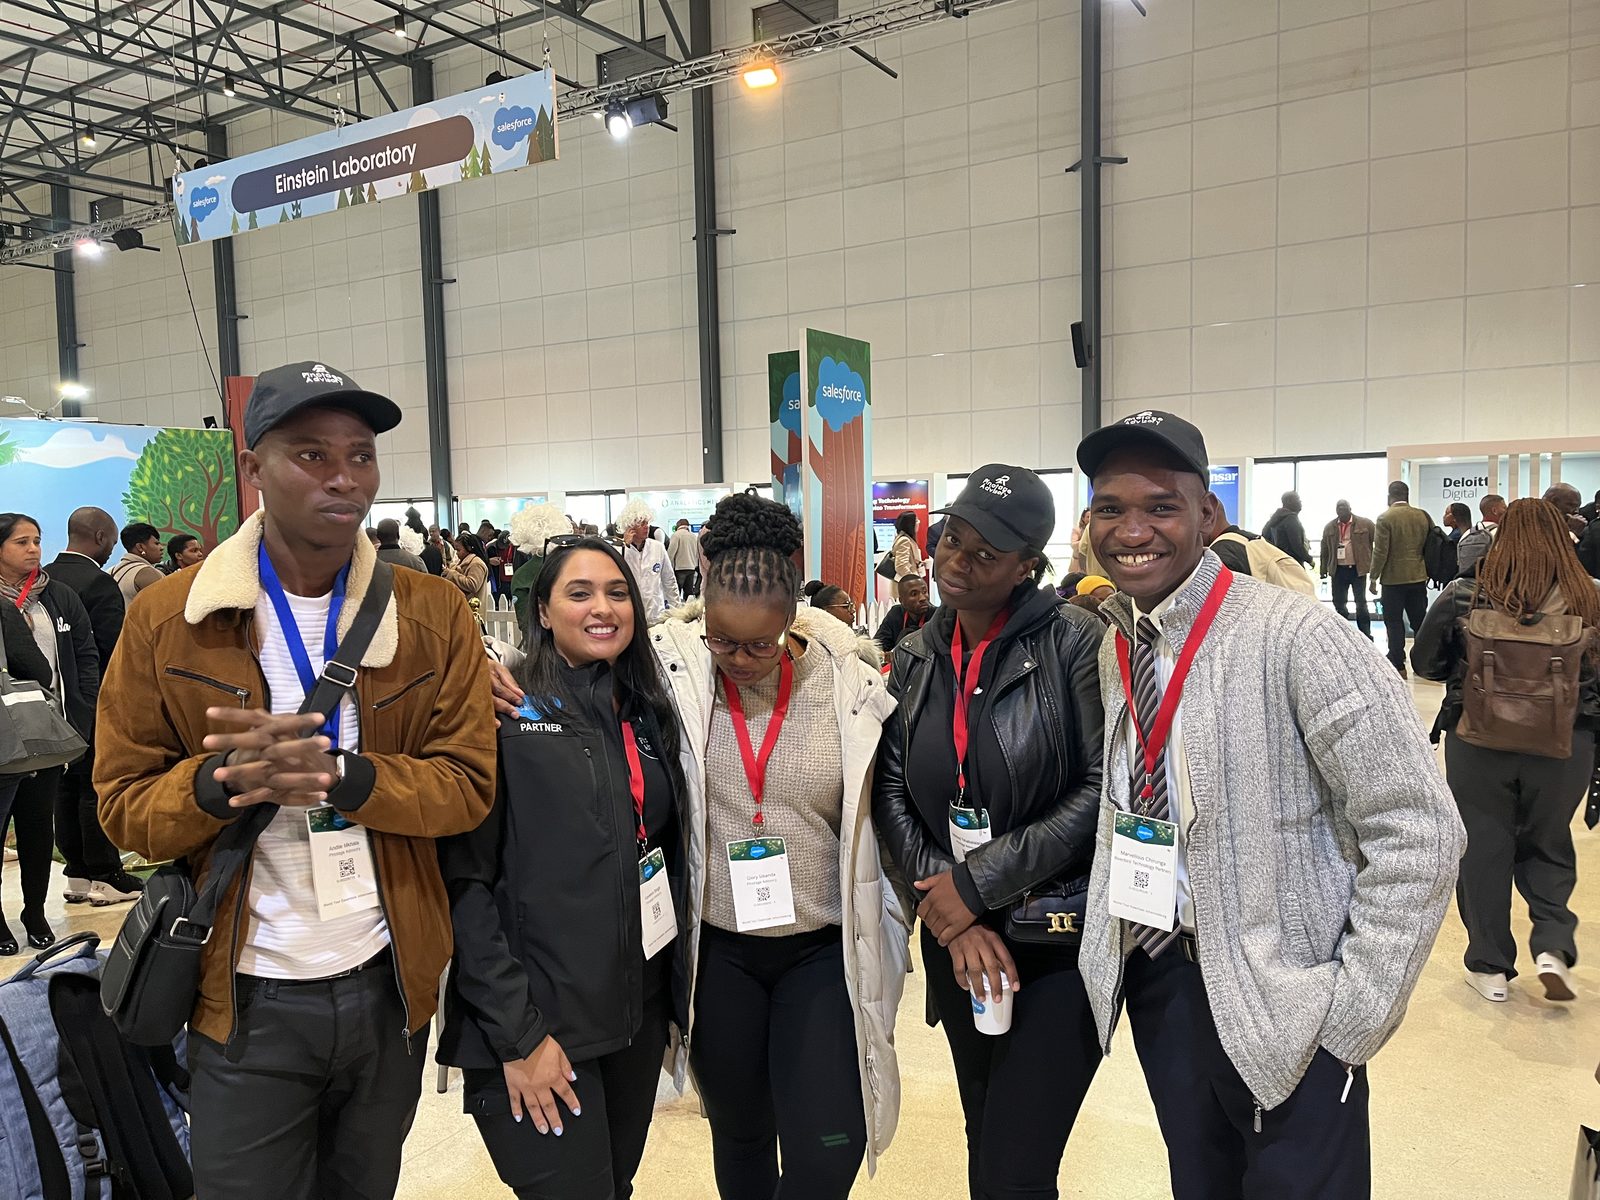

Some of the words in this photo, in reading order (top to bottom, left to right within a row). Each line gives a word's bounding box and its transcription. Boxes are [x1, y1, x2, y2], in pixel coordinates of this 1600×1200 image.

[497, 117, 533, 132] salesforce
[275, 164, 329, 194] Einstein
[332, 143, 417, 179] Laboratory
[193, 196, 217, 207] salesforce
[822, 383, 862, 404] salesforce
[980, 484, 1008, 499] Advisory
[1442, 487, 1478, 501] Digital
[520, 722, 563, 732] PARTNER
